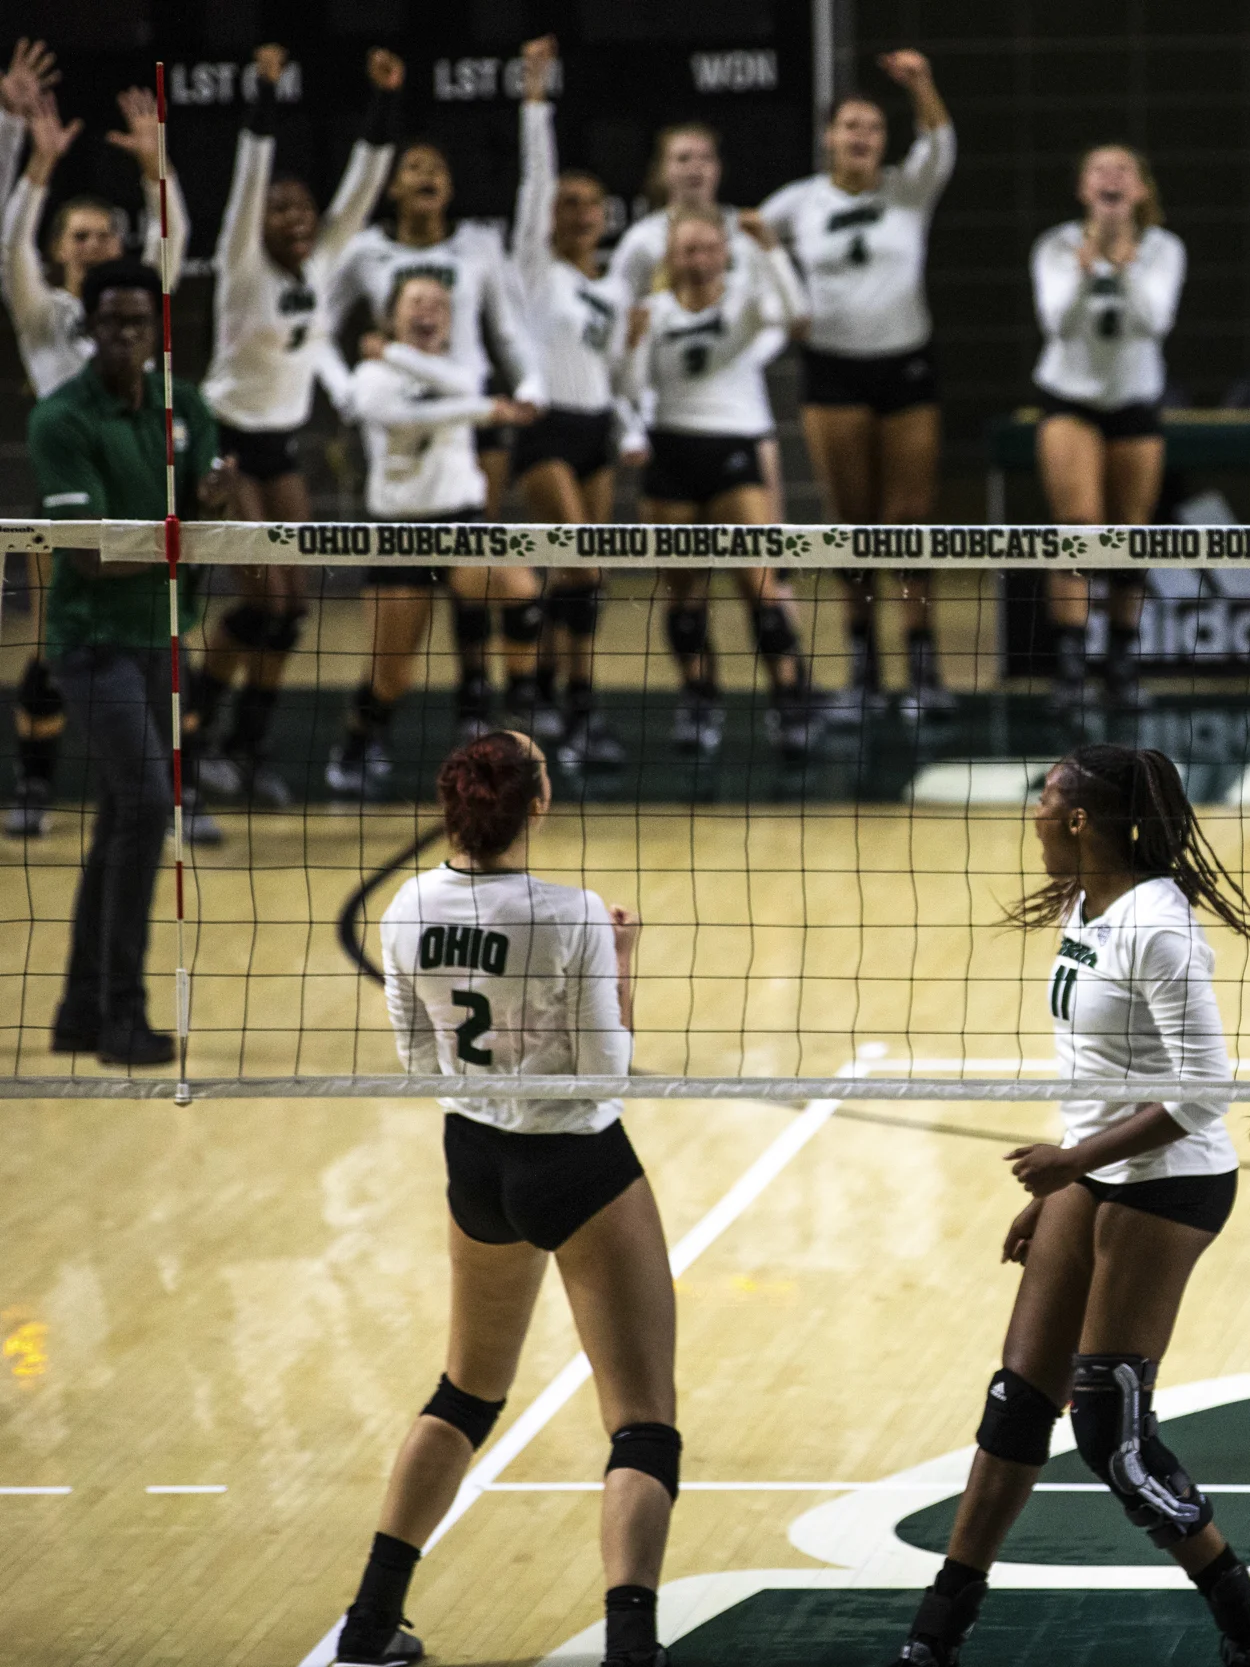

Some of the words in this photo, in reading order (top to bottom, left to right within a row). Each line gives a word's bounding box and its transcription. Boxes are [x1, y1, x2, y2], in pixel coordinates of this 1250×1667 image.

[169, 61, 238, 105] LST
[434, 57, 499, 100] LST
[690, 50, 778, 92] WON
[299, 526, 371, 555] OHIO
[377, 526, 508, 556] BOBCATS
[576, 528, 648, 557] OHIO
[654, 528, 783, 557] BOBCATS
[852, 529, 923, 558] OHIO
[930, 529, 1059, 558] BOBCATS
[1128, 529, 1200, 559] OHIO
[420, 925, 509, 976] OHIO
[1051, 965, 1078, 1021] 11
[452, 990, 492, 1067] 2
